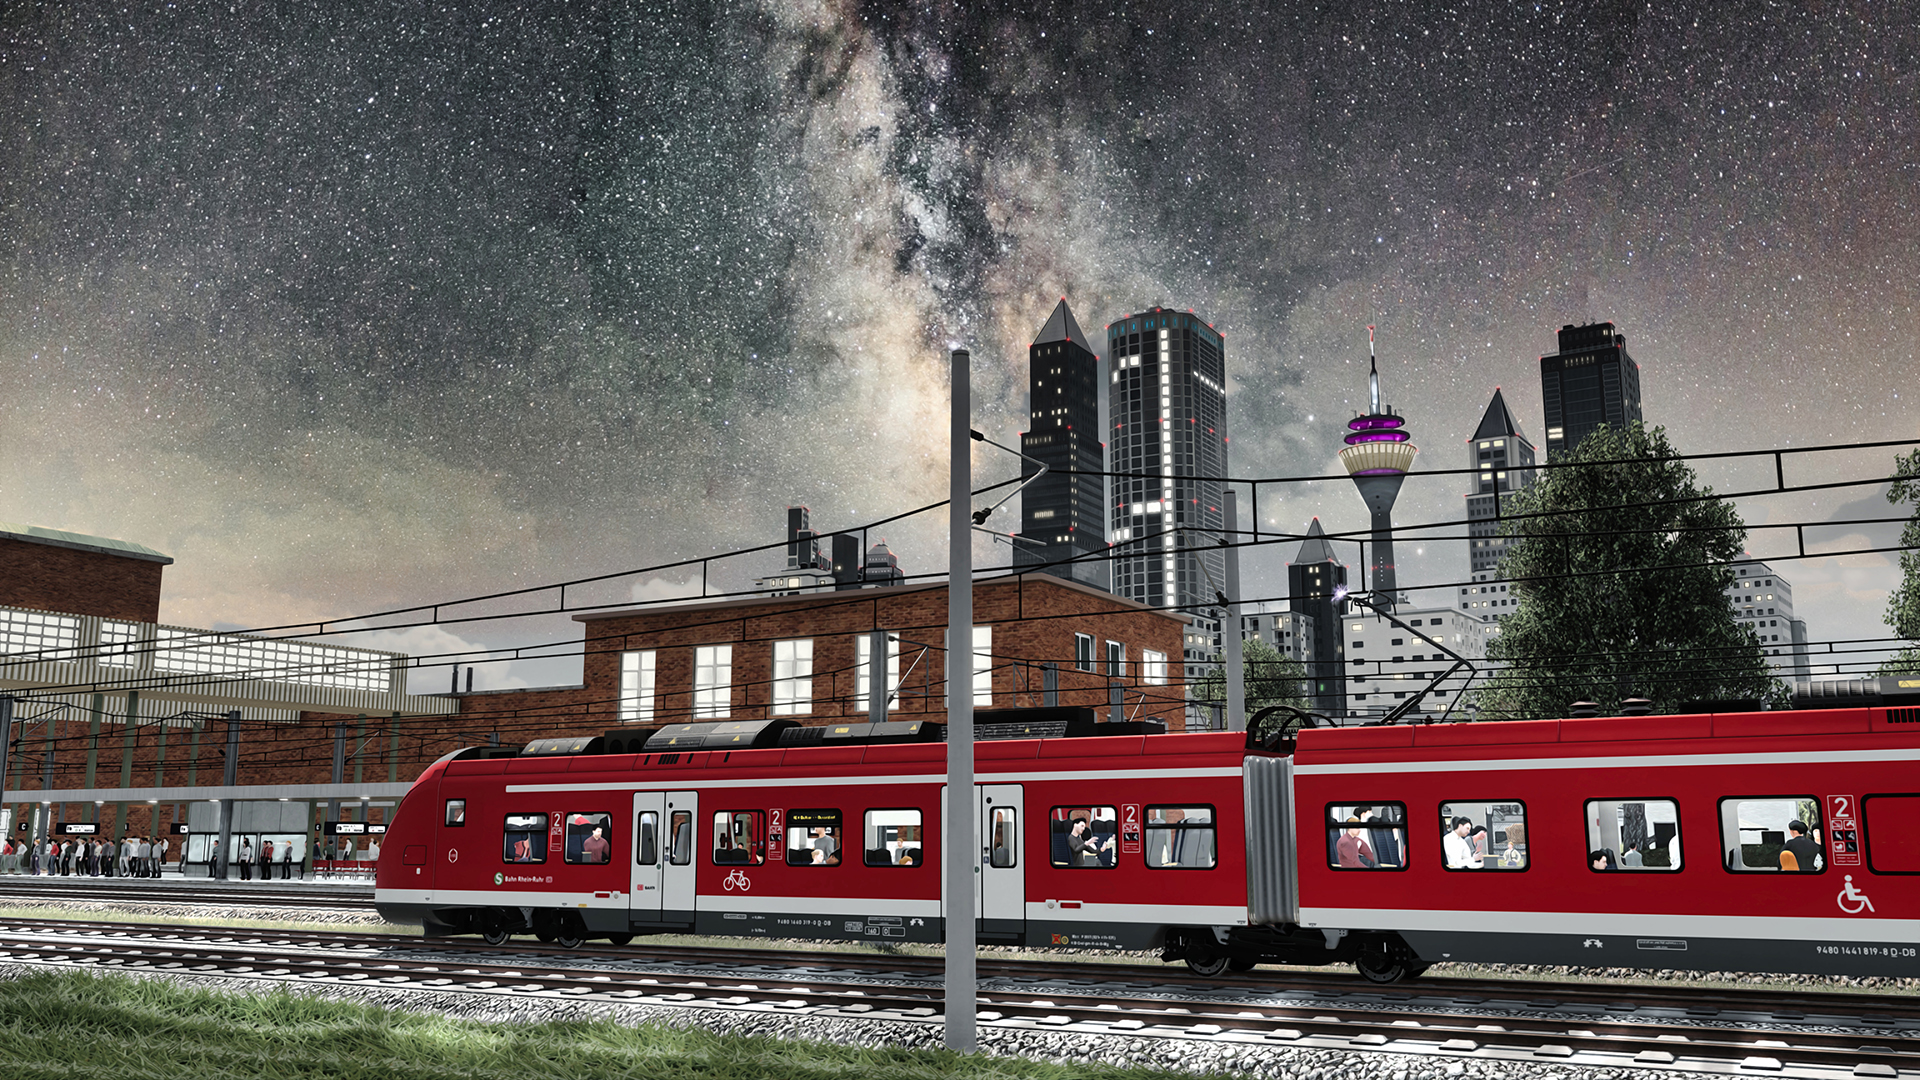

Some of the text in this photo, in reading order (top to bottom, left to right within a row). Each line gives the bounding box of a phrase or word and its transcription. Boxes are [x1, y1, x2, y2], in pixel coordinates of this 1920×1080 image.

[1126, 805, 1136, 822] 2
[1834, 797, 1848, 817] 2
[554, 813, 561, 827] 2
[772, 810, 780, 825] 2
[494, 871, 504, 886] S
[504, 875, 517, 883] Bahn
[1816, 945, 1917, 958] 9480 1441 819-8 D-DB
